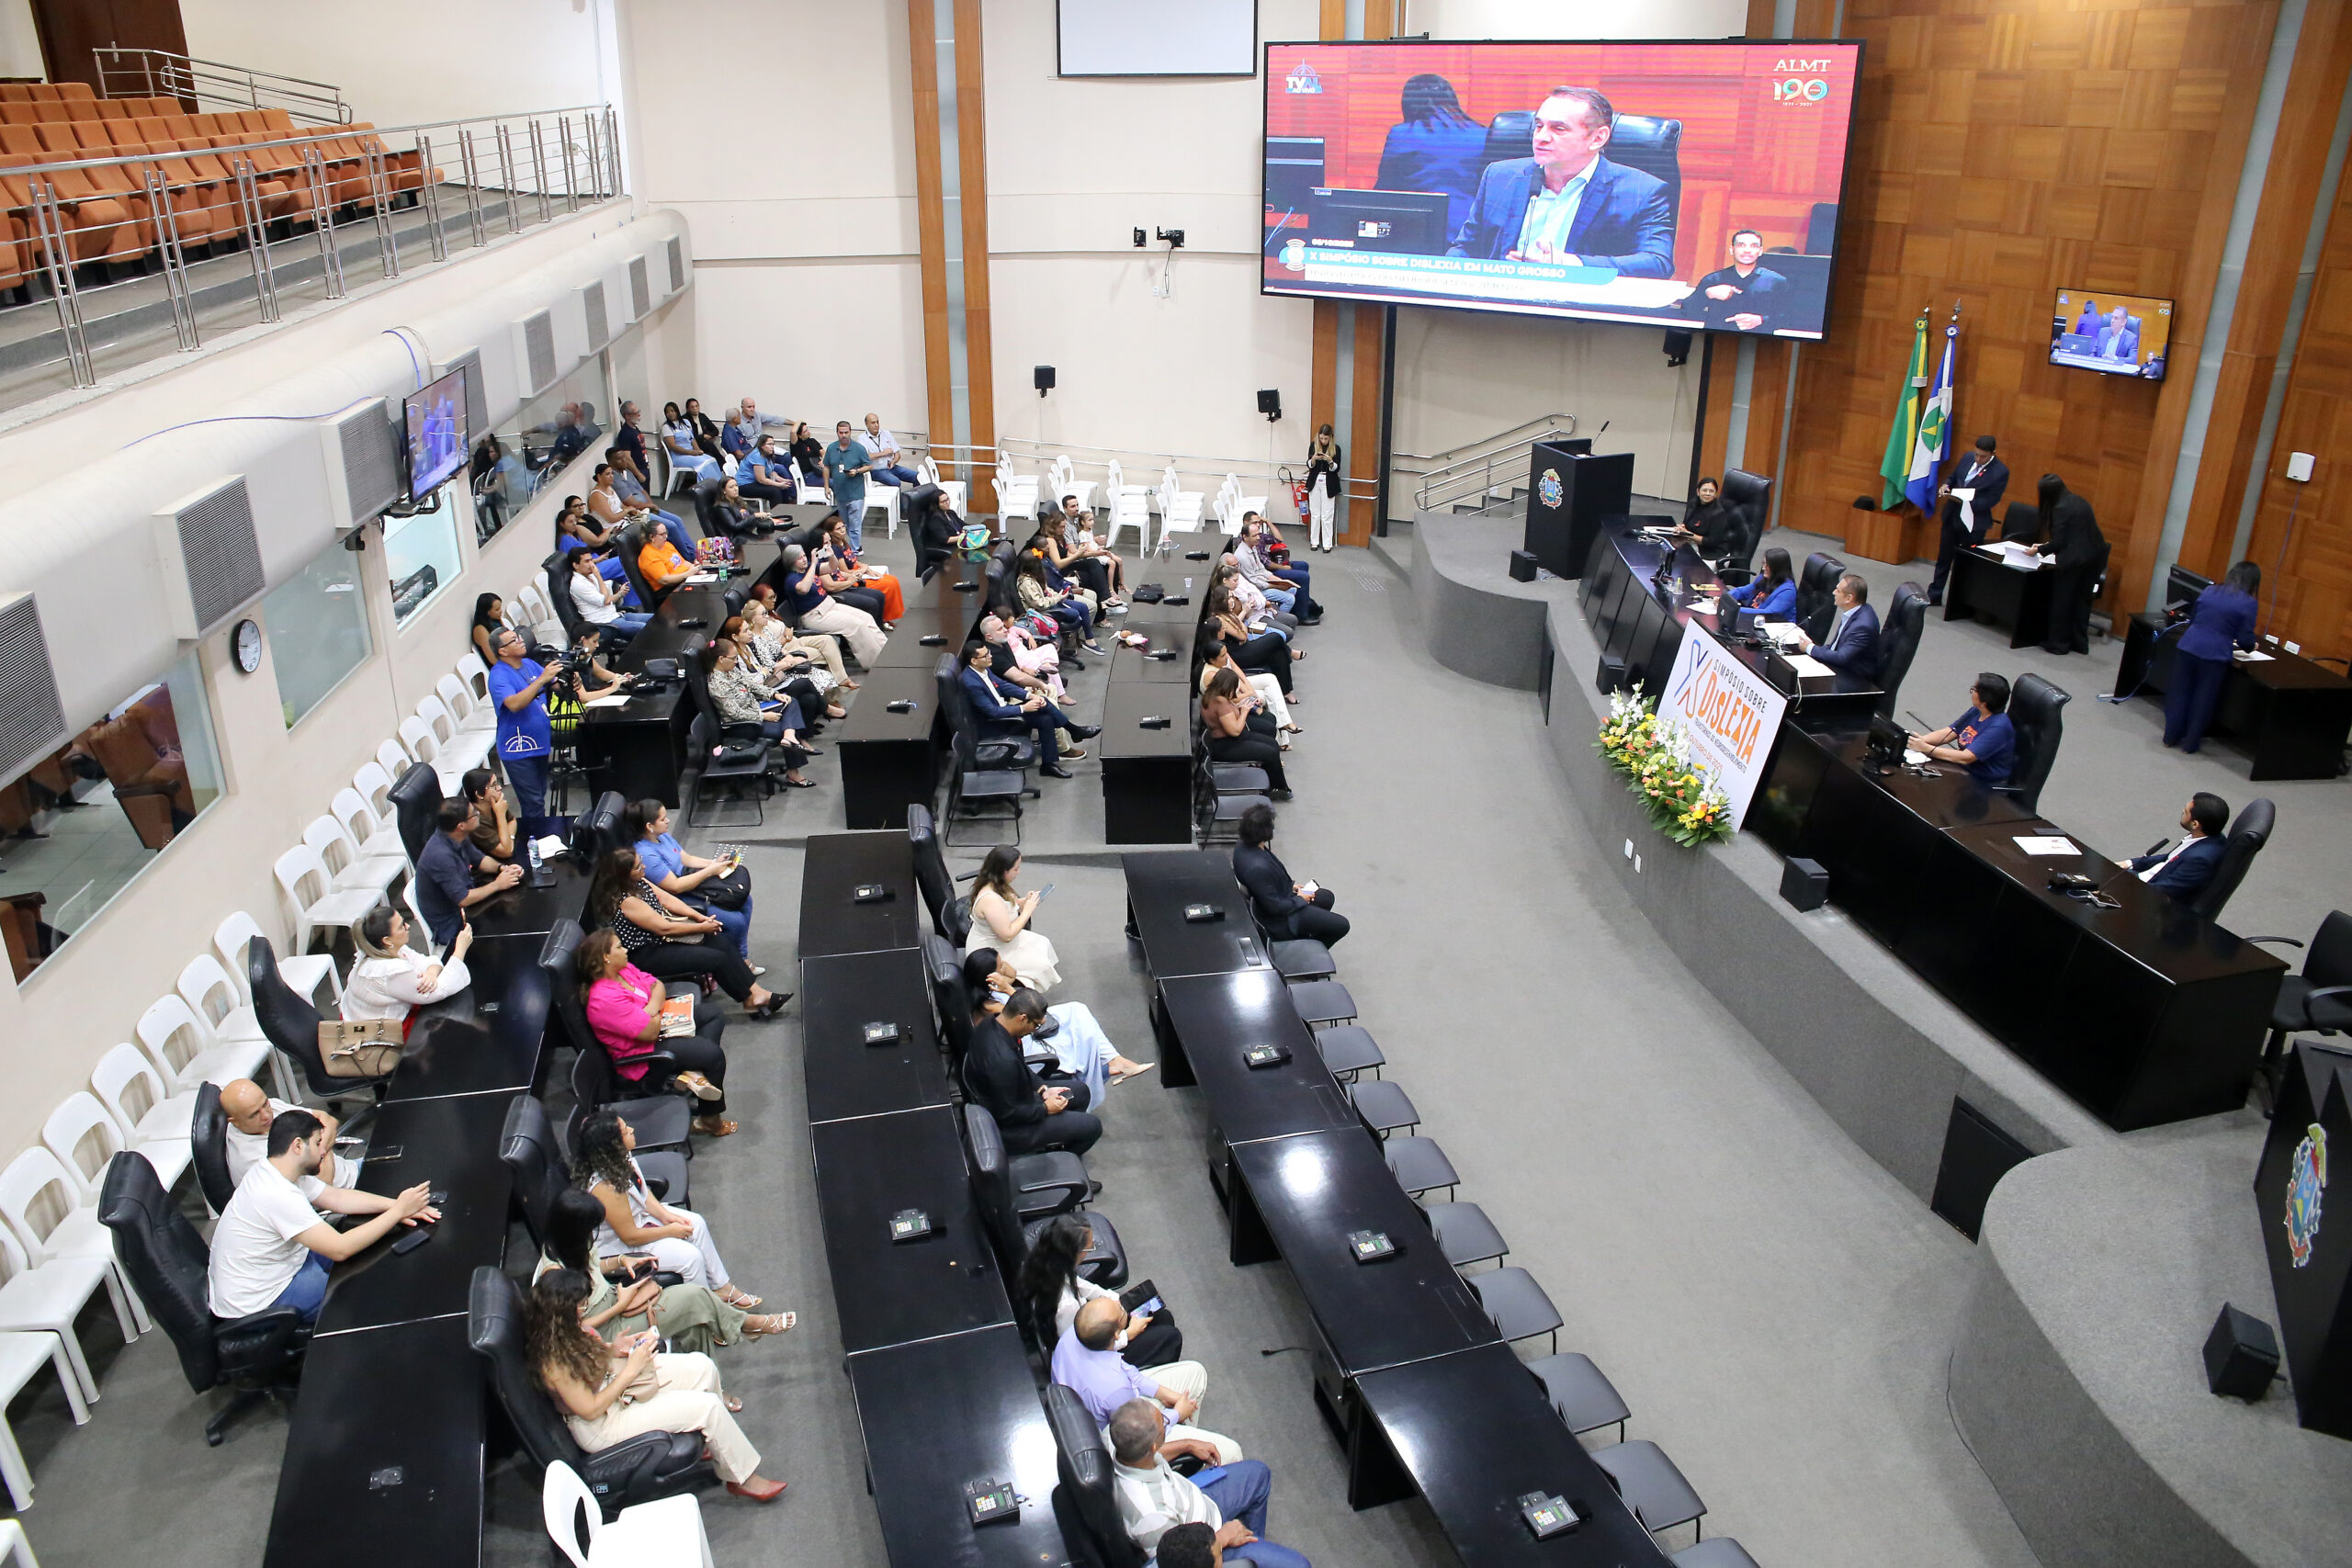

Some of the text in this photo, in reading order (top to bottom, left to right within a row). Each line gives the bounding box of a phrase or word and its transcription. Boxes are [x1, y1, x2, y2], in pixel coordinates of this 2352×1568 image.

[1773, 59, 1831, 72] ALMT
[1772, 78, 1829, 101] 190
[1309, 251, 1317, 261] X
[1319, 251, 1370, 265] SIMPÓSIO
[1372, 255, 1408, 267] SOBRE
[1410, 258, 1462, 271] DISLEXIA
[1464, 262, 1481, 273] EM
[1483, 264, 1516, 275] MATO
[1517, 266, 1566, 279] GROSSO
[1713, 659, 1744, 693] SIMPÓSIO
[1745, 686, 1768, 714] SOBRE
[1698, 671, 1762, 765] DISLEXIA
